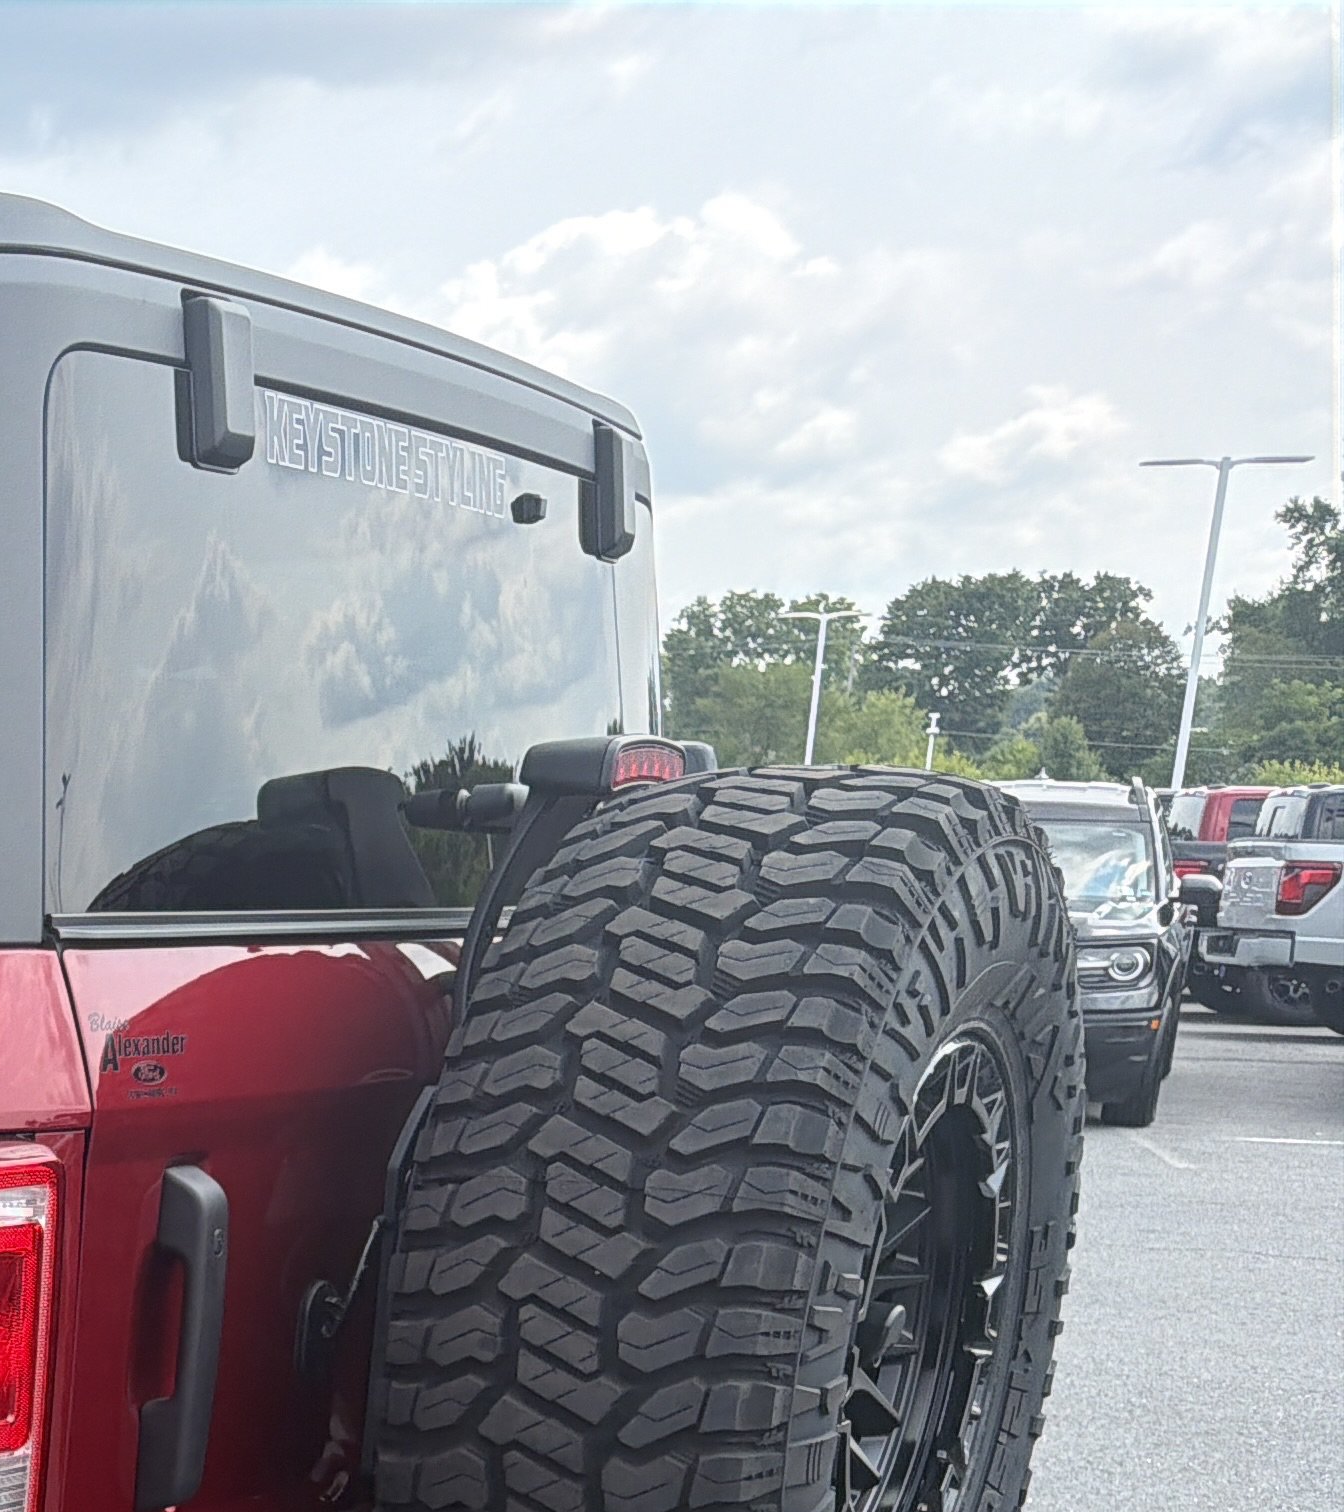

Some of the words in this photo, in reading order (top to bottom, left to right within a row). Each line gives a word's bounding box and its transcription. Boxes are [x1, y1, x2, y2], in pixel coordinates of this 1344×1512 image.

[264, 391, 409, 494] KEYSTONE
[412, 430, 505, 518] STYLING
[100, 1032, 186, 1073] Alexander
